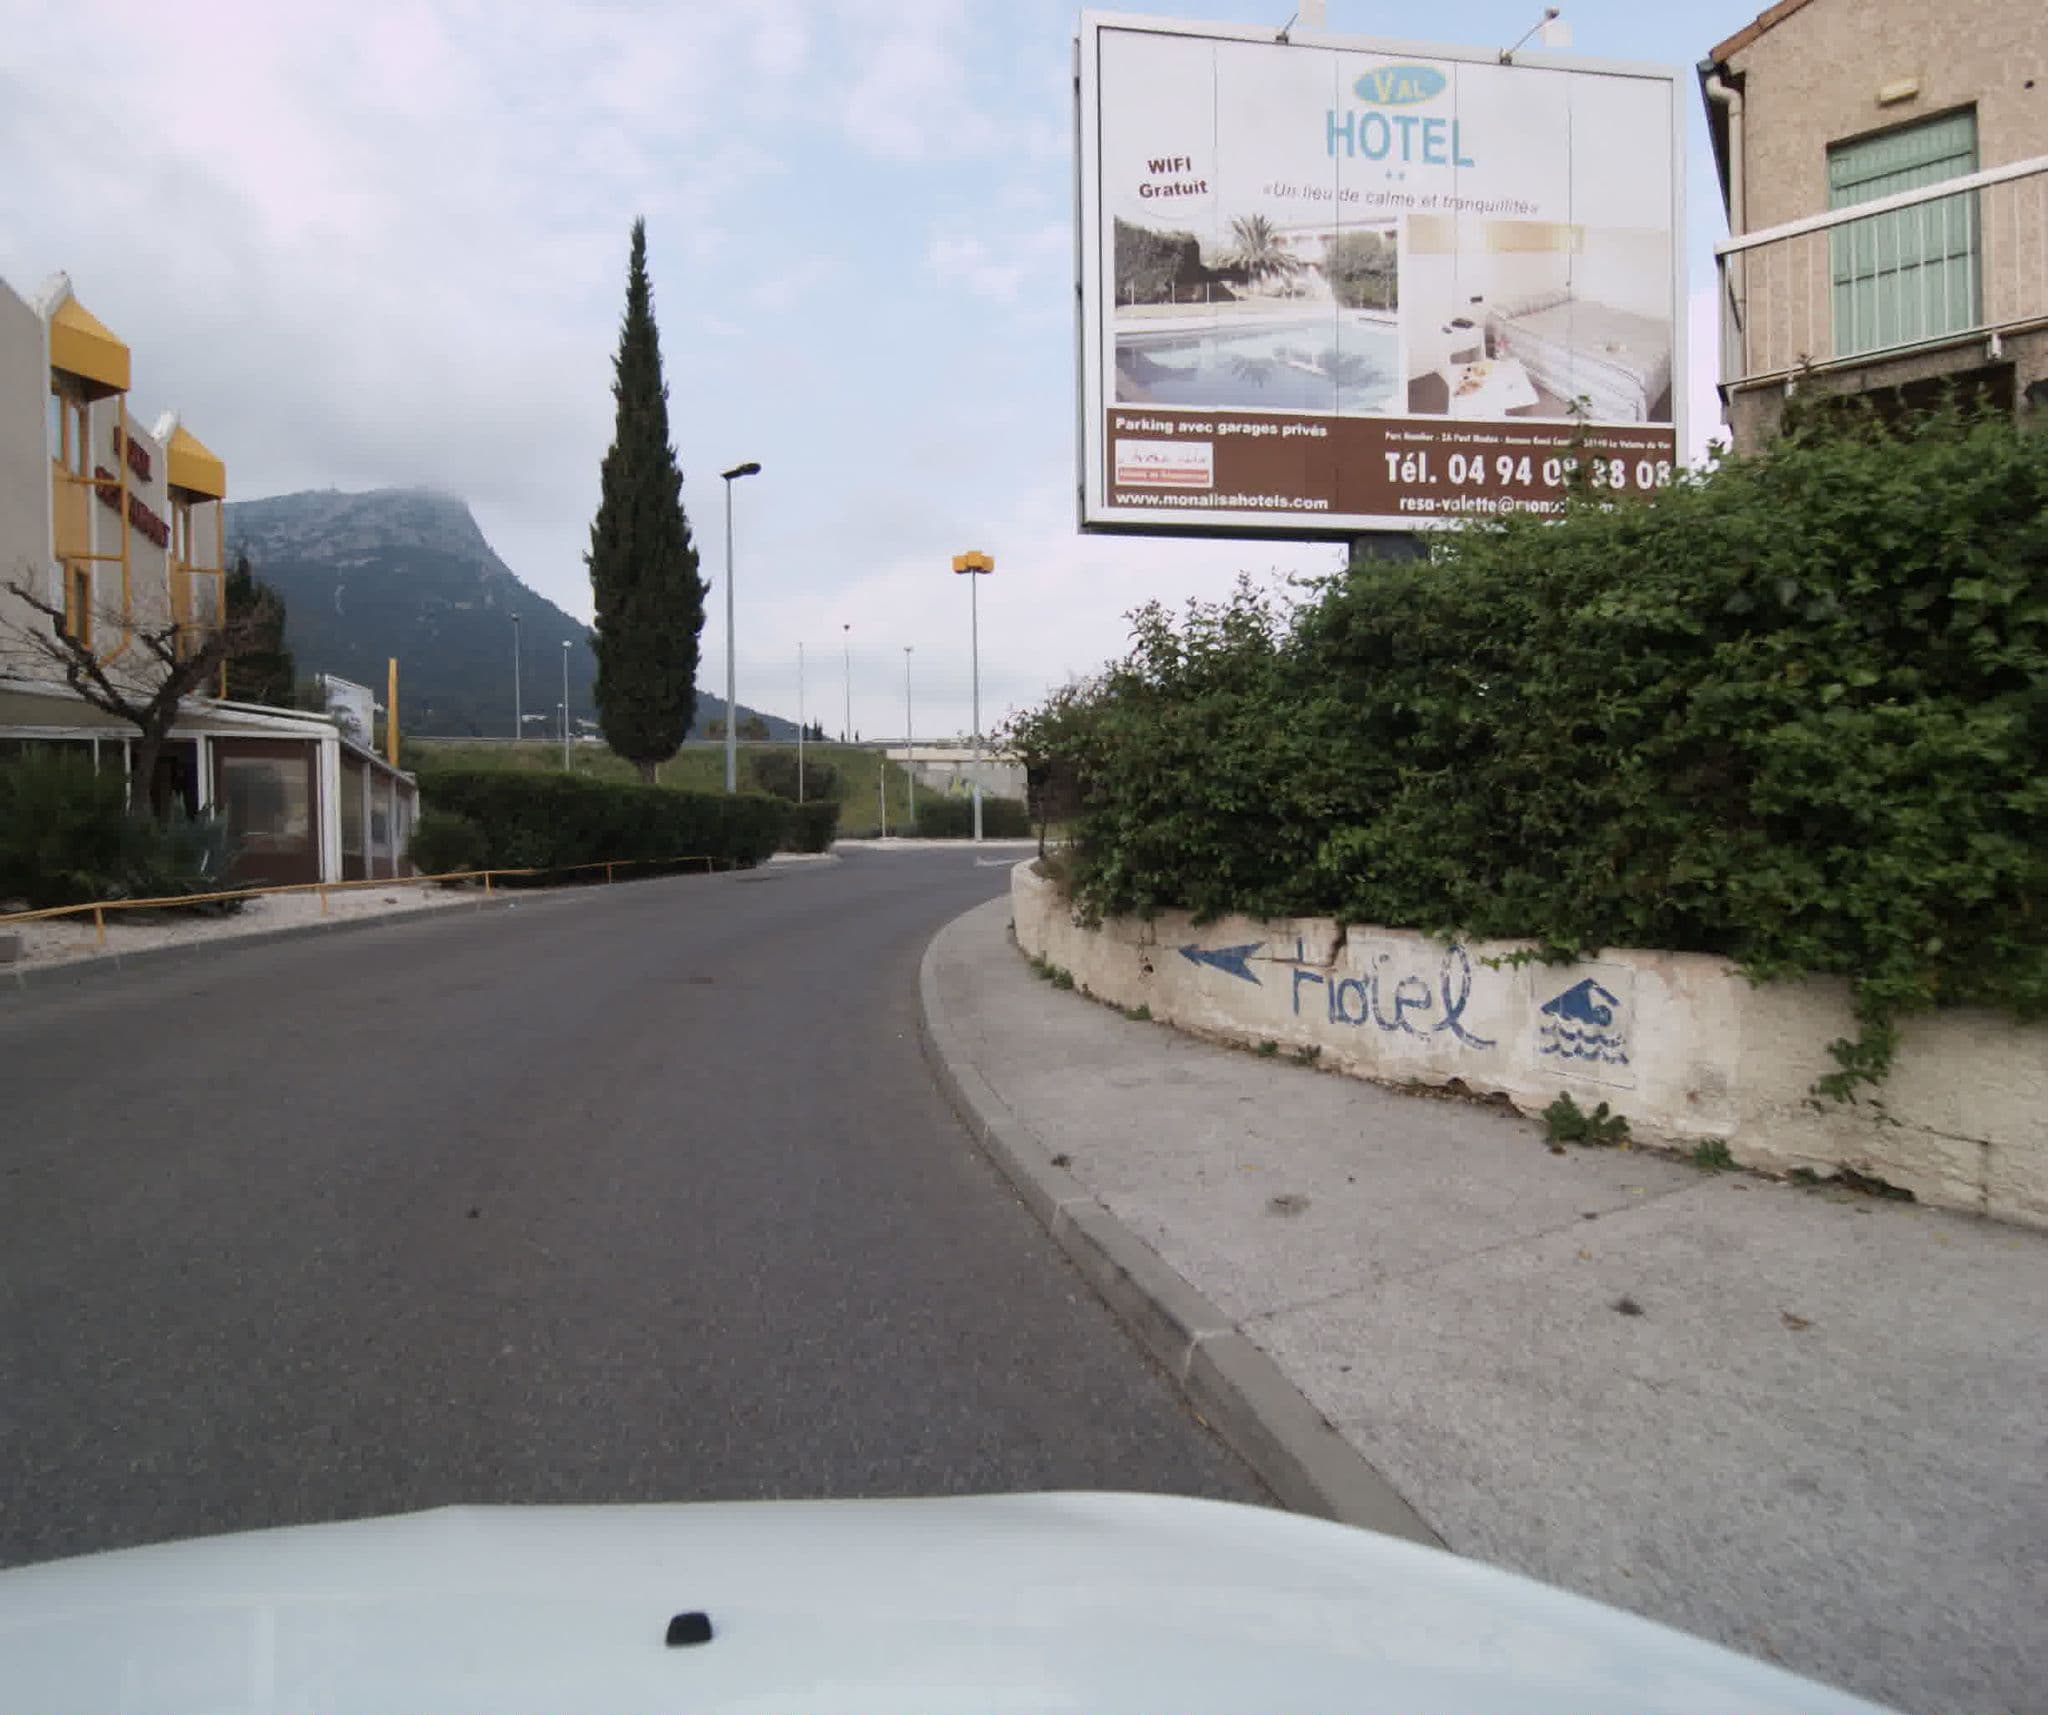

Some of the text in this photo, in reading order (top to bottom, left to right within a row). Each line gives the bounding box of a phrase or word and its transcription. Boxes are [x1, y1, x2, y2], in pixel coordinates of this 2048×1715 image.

[1326, 109, 1476, 168] HOTEL
[1147, 156, 1192, 175] WIFI
[1139, 180, 1208, 198] Gratuit
[1302, 184, 1332, 201] lieu
[1339, 186, 1361, 202] de
[1366, 188, 1414, 208] calme
[1421, 192, 1438, 208] et
[1115, 417, 1328, 438] Parking avec garages privés
[1384, 451, 1438, 484] Tél.
[1448, 453, 1486, 486] 04
[1495, 455, 1533, 487] 94
[1115, 492, 1329, 510] www.monalisahotels.com
[1293, 936, 1497, 1050] Hotel
